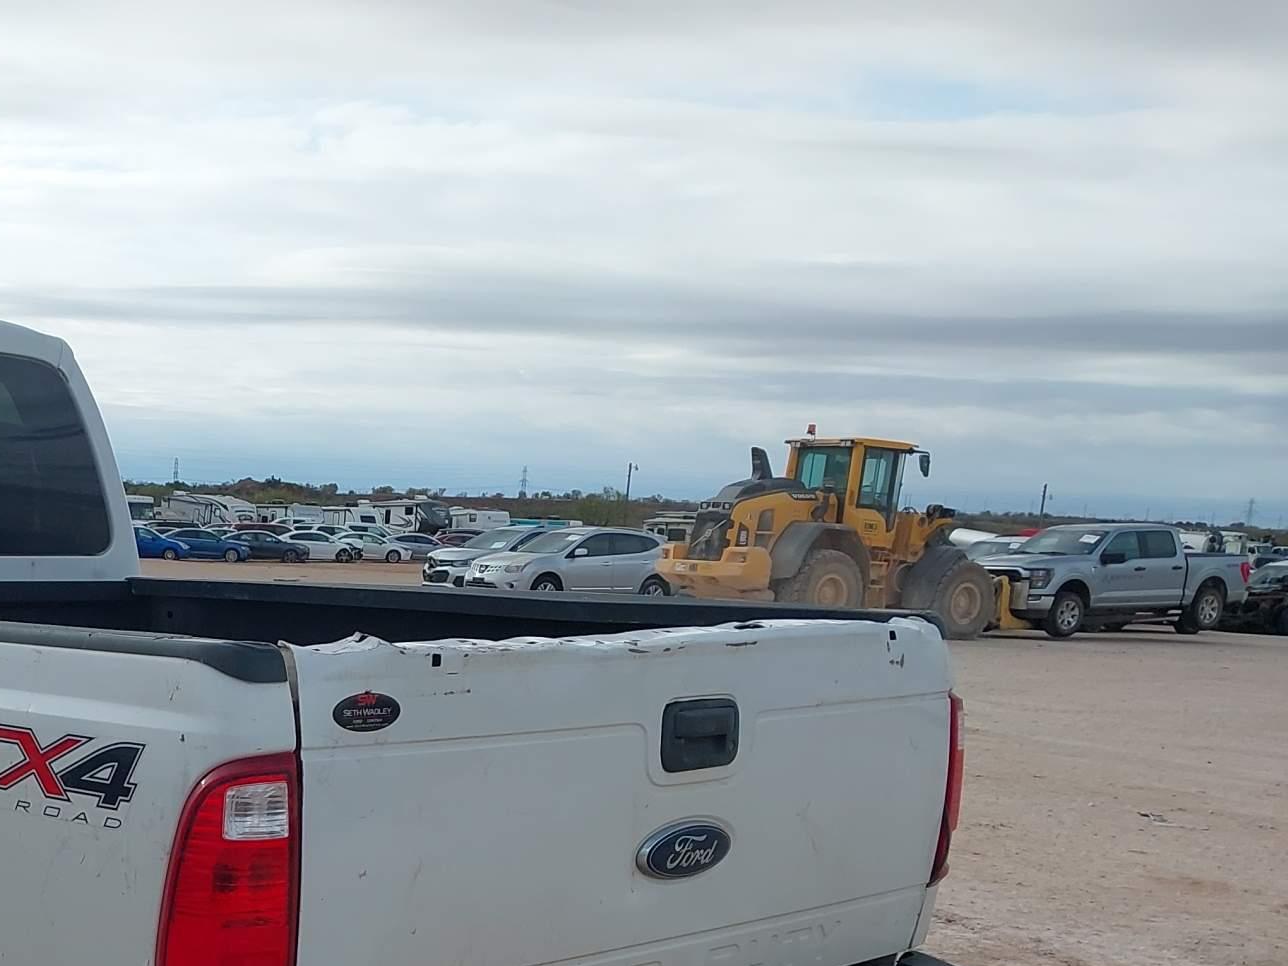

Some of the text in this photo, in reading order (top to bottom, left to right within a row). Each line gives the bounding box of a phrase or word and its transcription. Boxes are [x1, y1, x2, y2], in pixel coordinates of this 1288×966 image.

[343, 706, 392, 717] SETH WADLEY
[15, 800, 122, 829] ROAD
[666, 834, 718, 869] Ford
